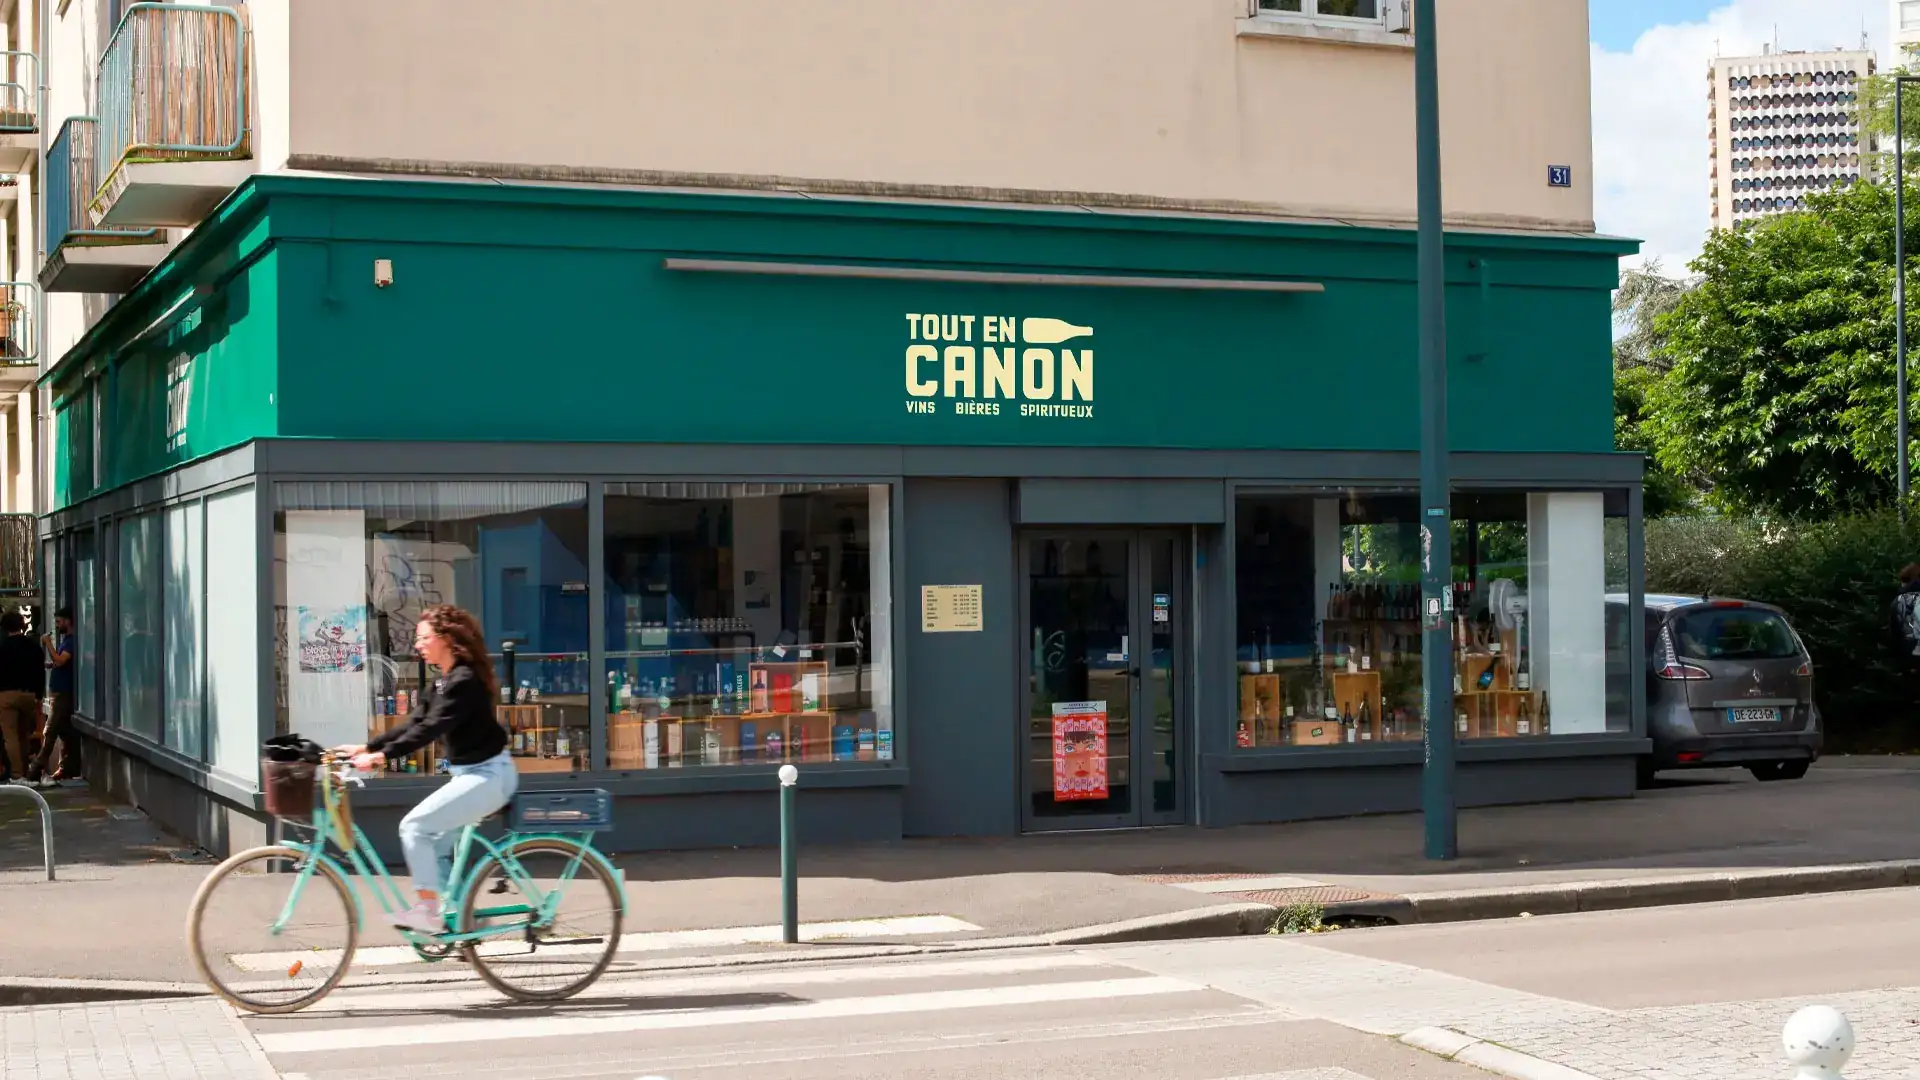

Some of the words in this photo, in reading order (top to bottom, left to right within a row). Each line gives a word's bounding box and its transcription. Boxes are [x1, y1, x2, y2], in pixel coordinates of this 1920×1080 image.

[1553, 168, 1567, 184] 31
[905, 313, 976, 342] TOUT
[983, 315, 1016, 343] EN
[905, 344, 1094, 402] CANON
[905, 400, 936, 414] VINS
[955, 400, 1000, 416] BIÈRES
[1020, 403, 1094, 418] SPIRITUEUX
